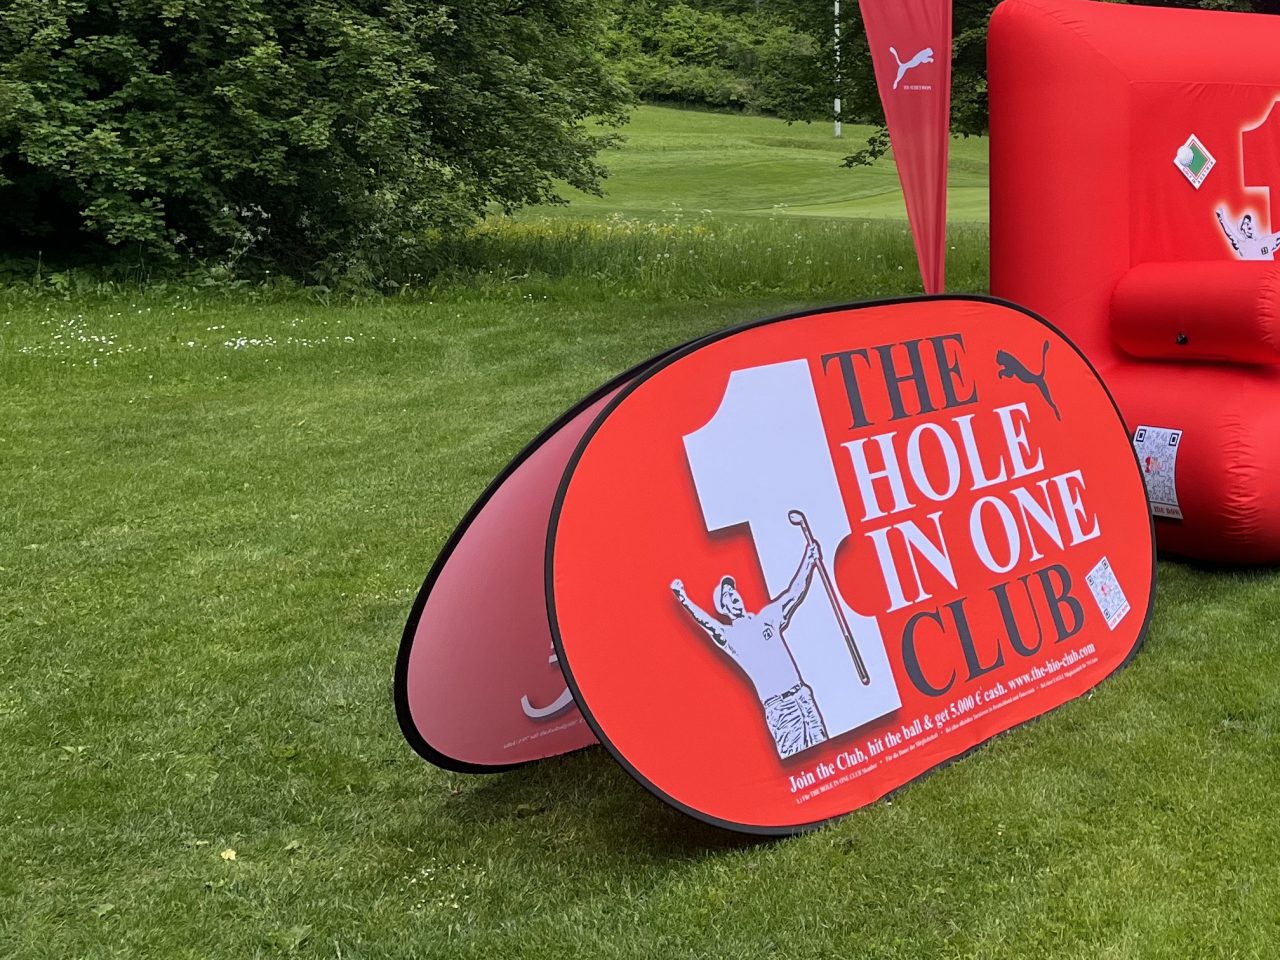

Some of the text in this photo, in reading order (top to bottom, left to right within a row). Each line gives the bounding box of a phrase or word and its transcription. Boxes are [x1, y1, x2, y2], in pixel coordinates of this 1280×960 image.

[821, 333, 979, 430] THE
[840, 402, 1045, 523] HOLE
[865, 469, 1101, 613] IN ONE
[902, 564, 1085, 697] CLUB
[789, 770, 816, 793] Join
[816, 762, 835, 779] the
[836, 746, 868, 770] Club,
[867, 738, 884, 756] hit
[885, 731, 903, 748] the
[901, 720, 923, 739] ball
[924, 714, 933, 730] &
[935, 710, 950, 729] get
[950, 695, 975, 717] 5.000
[983, 682, 1008, 702] cash.
[1008, 643, 1096, 690] www.the-hio-club.com
